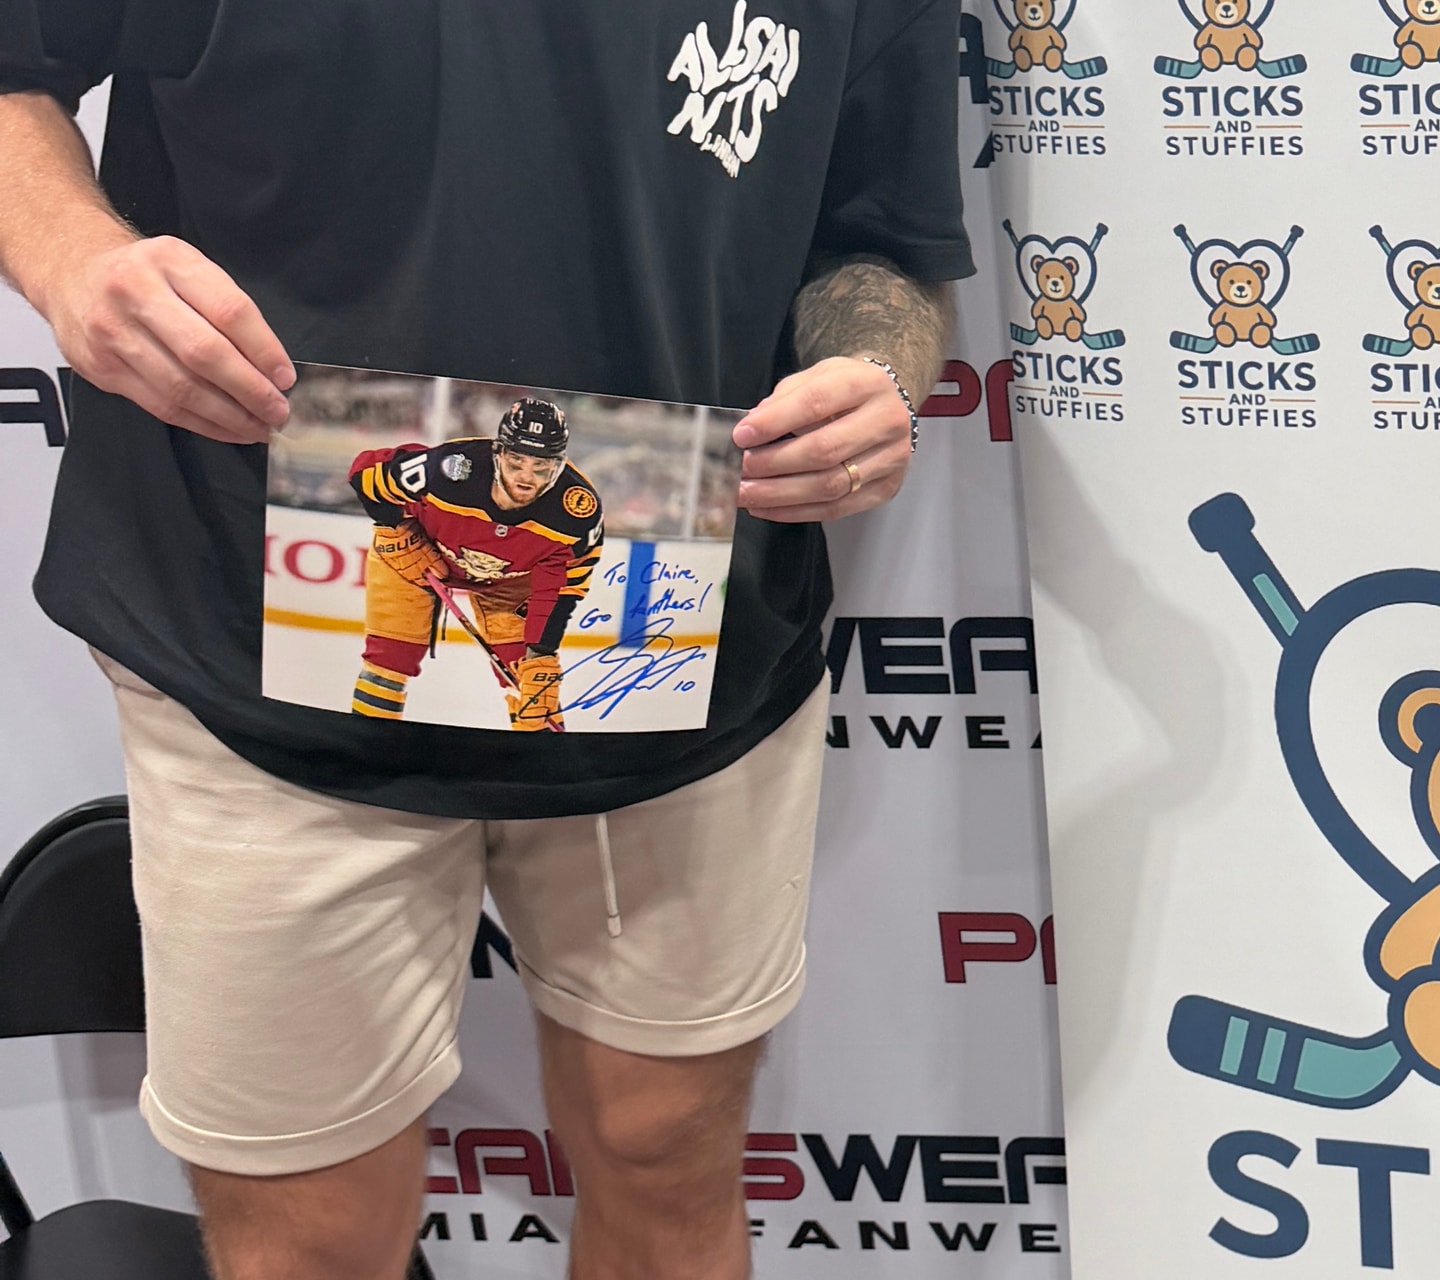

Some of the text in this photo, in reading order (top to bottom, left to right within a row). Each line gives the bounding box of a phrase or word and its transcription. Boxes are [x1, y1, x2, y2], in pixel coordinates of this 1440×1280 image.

[989, 86, 1105, 118] STICKS
[1162, 85, 1304, 118] STICKS
[1029, 121, 1060, 133] AND
[1214, 120, 1252, 134] AND
[992, 134, 1107, 156] STUFFIES
[1165, 135, 1304, 157] STUFFIES
[1012, 350, 1123, 387] STICKS
[1177, 360, 1317, 393] STICKS
[1049, 385, 1080, 400] AND
[1228, 393, 1266, 407] AND
[1015, 394, 1125, 424] STUFFIES
[1181, 407, 1317, 430] STUFFIES
[604, 561, 627, 587] To
[579, 607, 613, 629] Go
